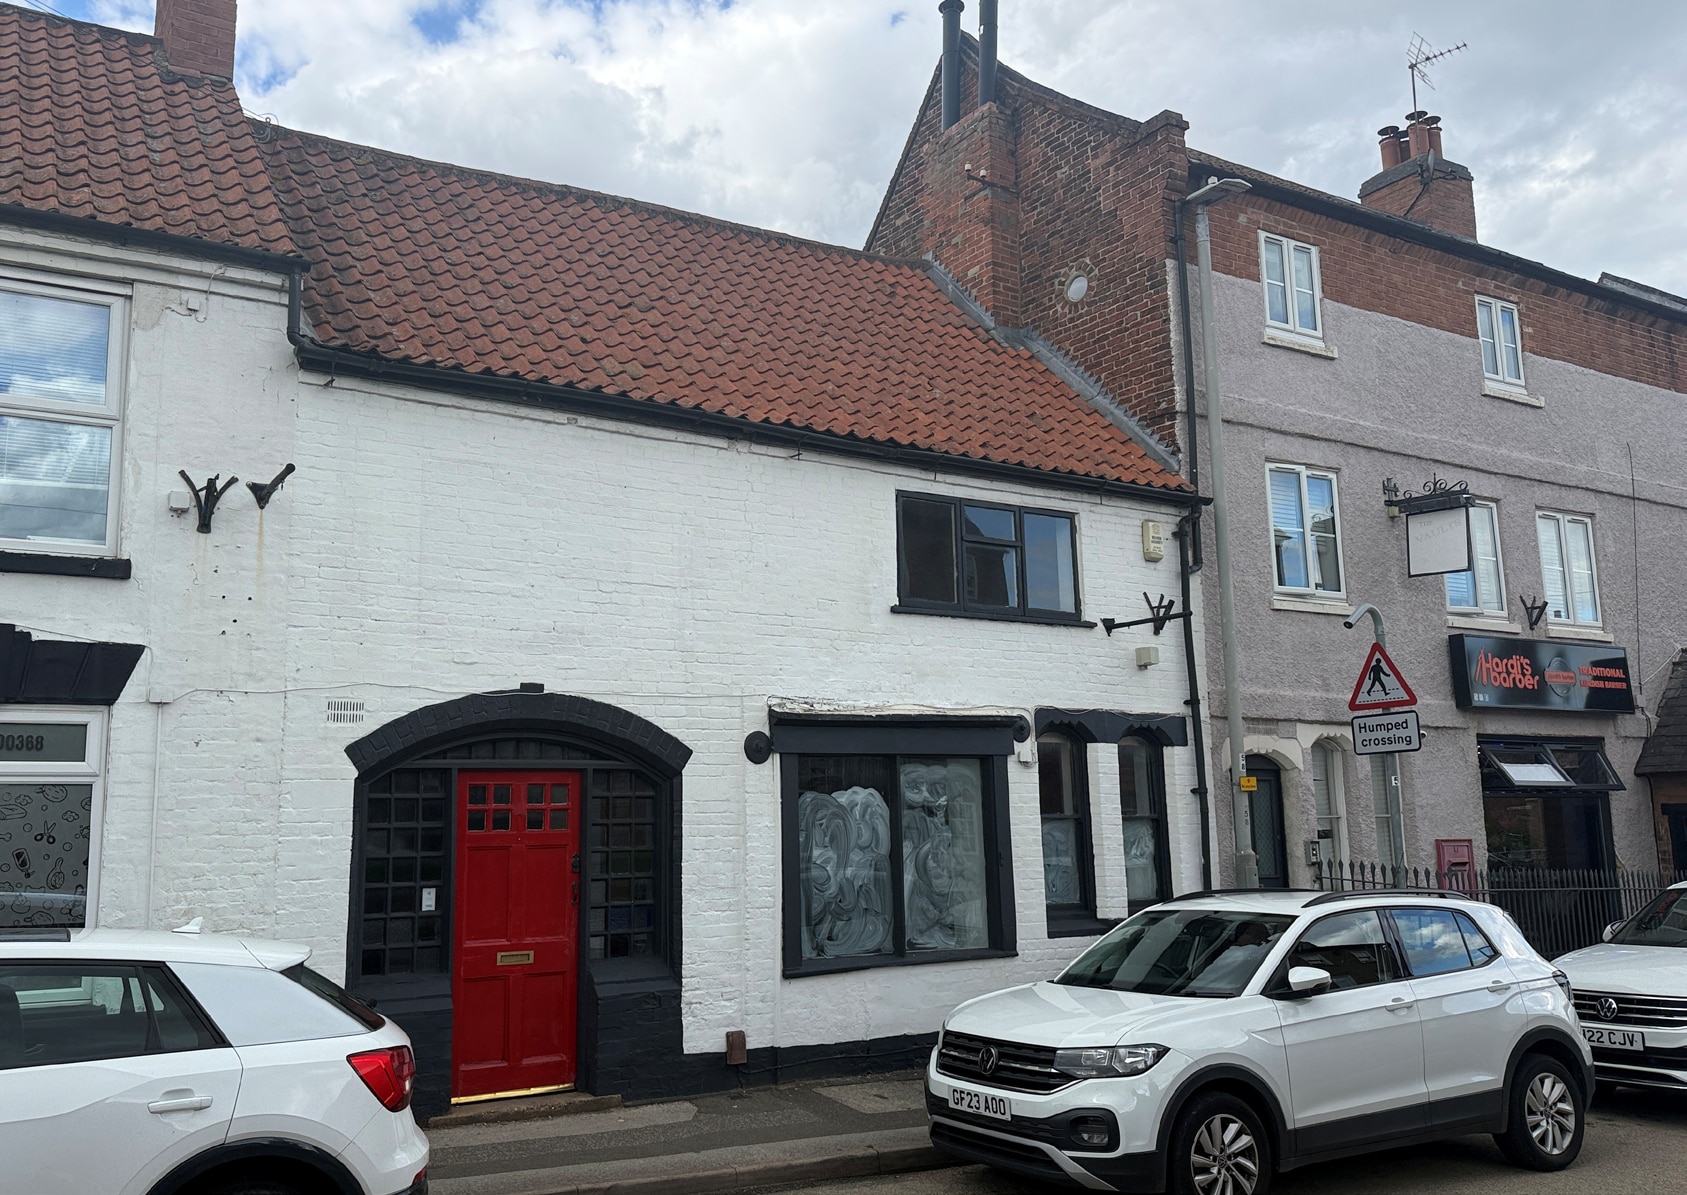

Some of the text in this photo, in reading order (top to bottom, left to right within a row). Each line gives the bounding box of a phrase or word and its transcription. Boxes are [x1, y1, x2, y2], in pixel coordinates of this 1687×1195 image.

[1475, 647, 1532, 685] Hardi's
[1578, 665, 1626, 679] TRADITIONAL
[1490, 671, 1540, 690] barber
[1358, 718, 1409, 733] Humped
[1361, 734, 1412, 747] crossing
[1608, 1031, 1634, 1047] CJV
[952, 1088, 980, 1110] GF23
